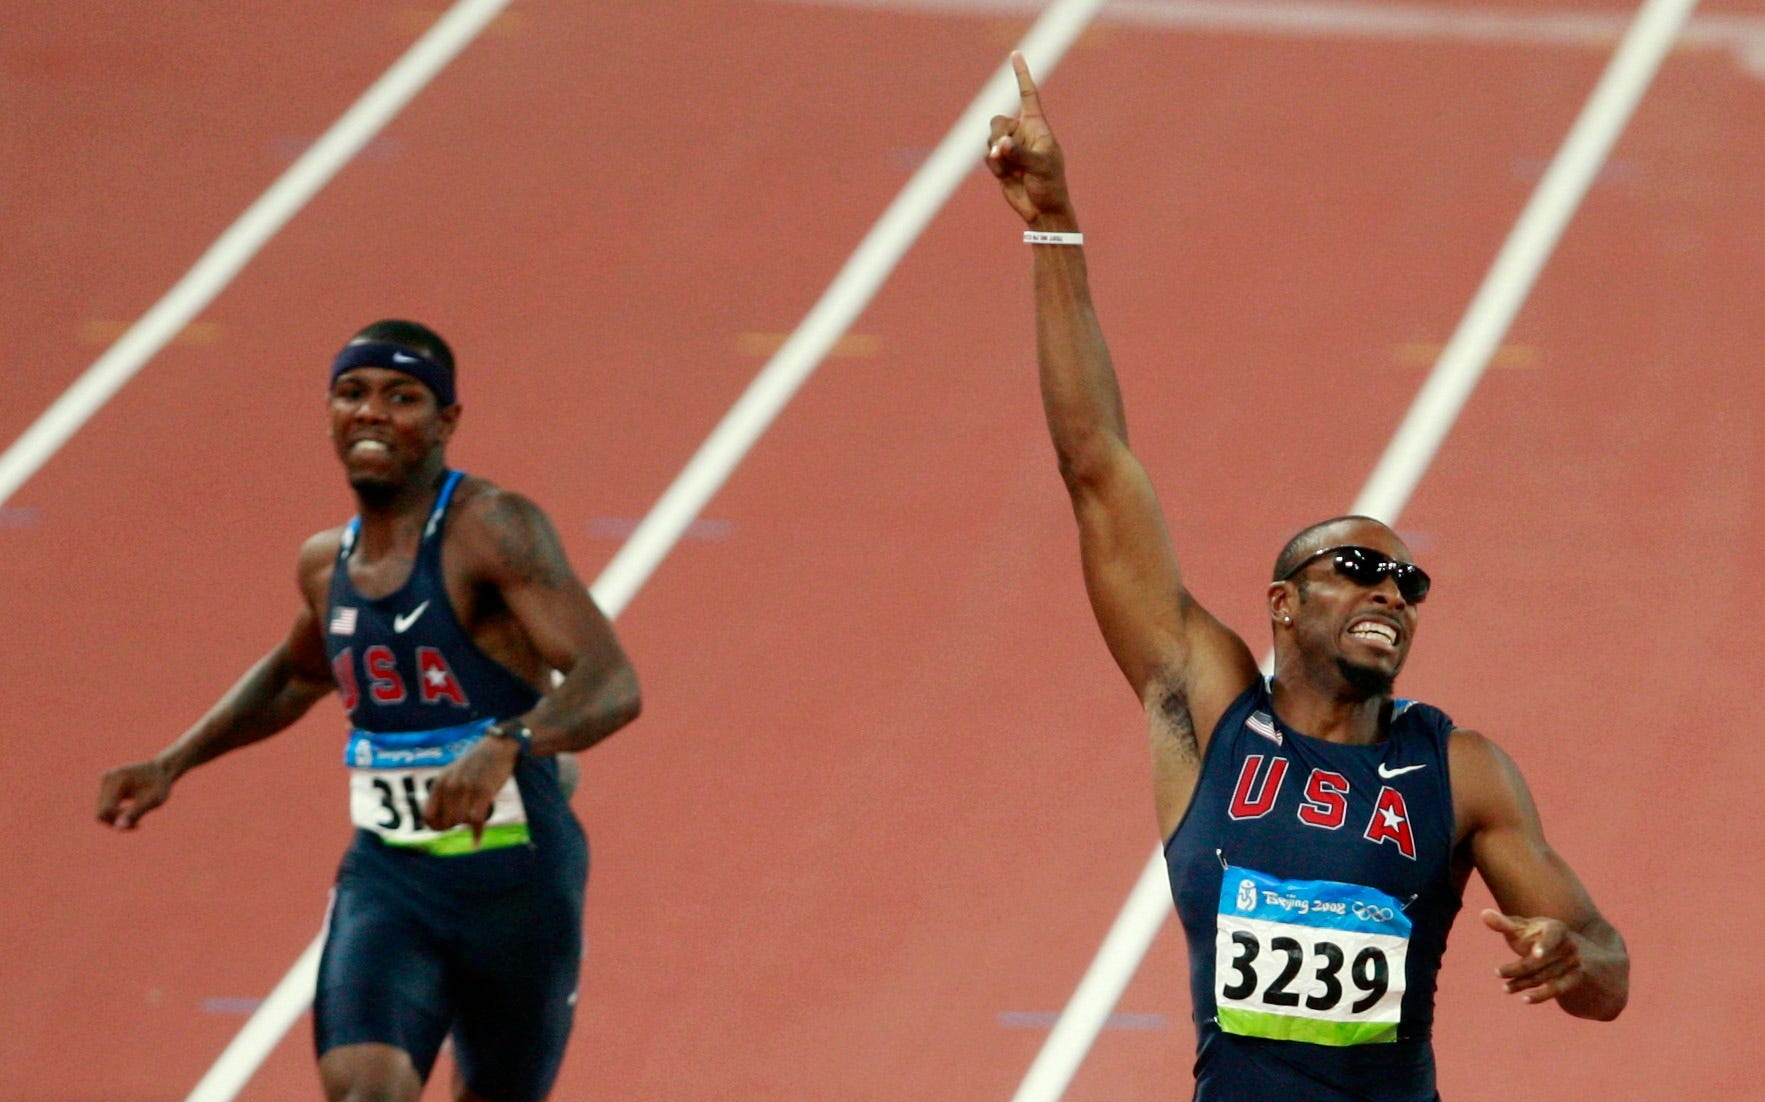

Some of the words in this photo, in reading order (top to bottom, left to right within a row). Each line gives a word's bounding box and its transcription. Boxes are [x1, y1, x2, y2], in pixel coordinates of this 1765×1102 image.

[1228, 754, 1417, 861] USA
[1262, 891, 1309, 914] Beijing
[1311, 900, 1346, 914] 2008
[1222, 930, 1389, 1014] 3239
